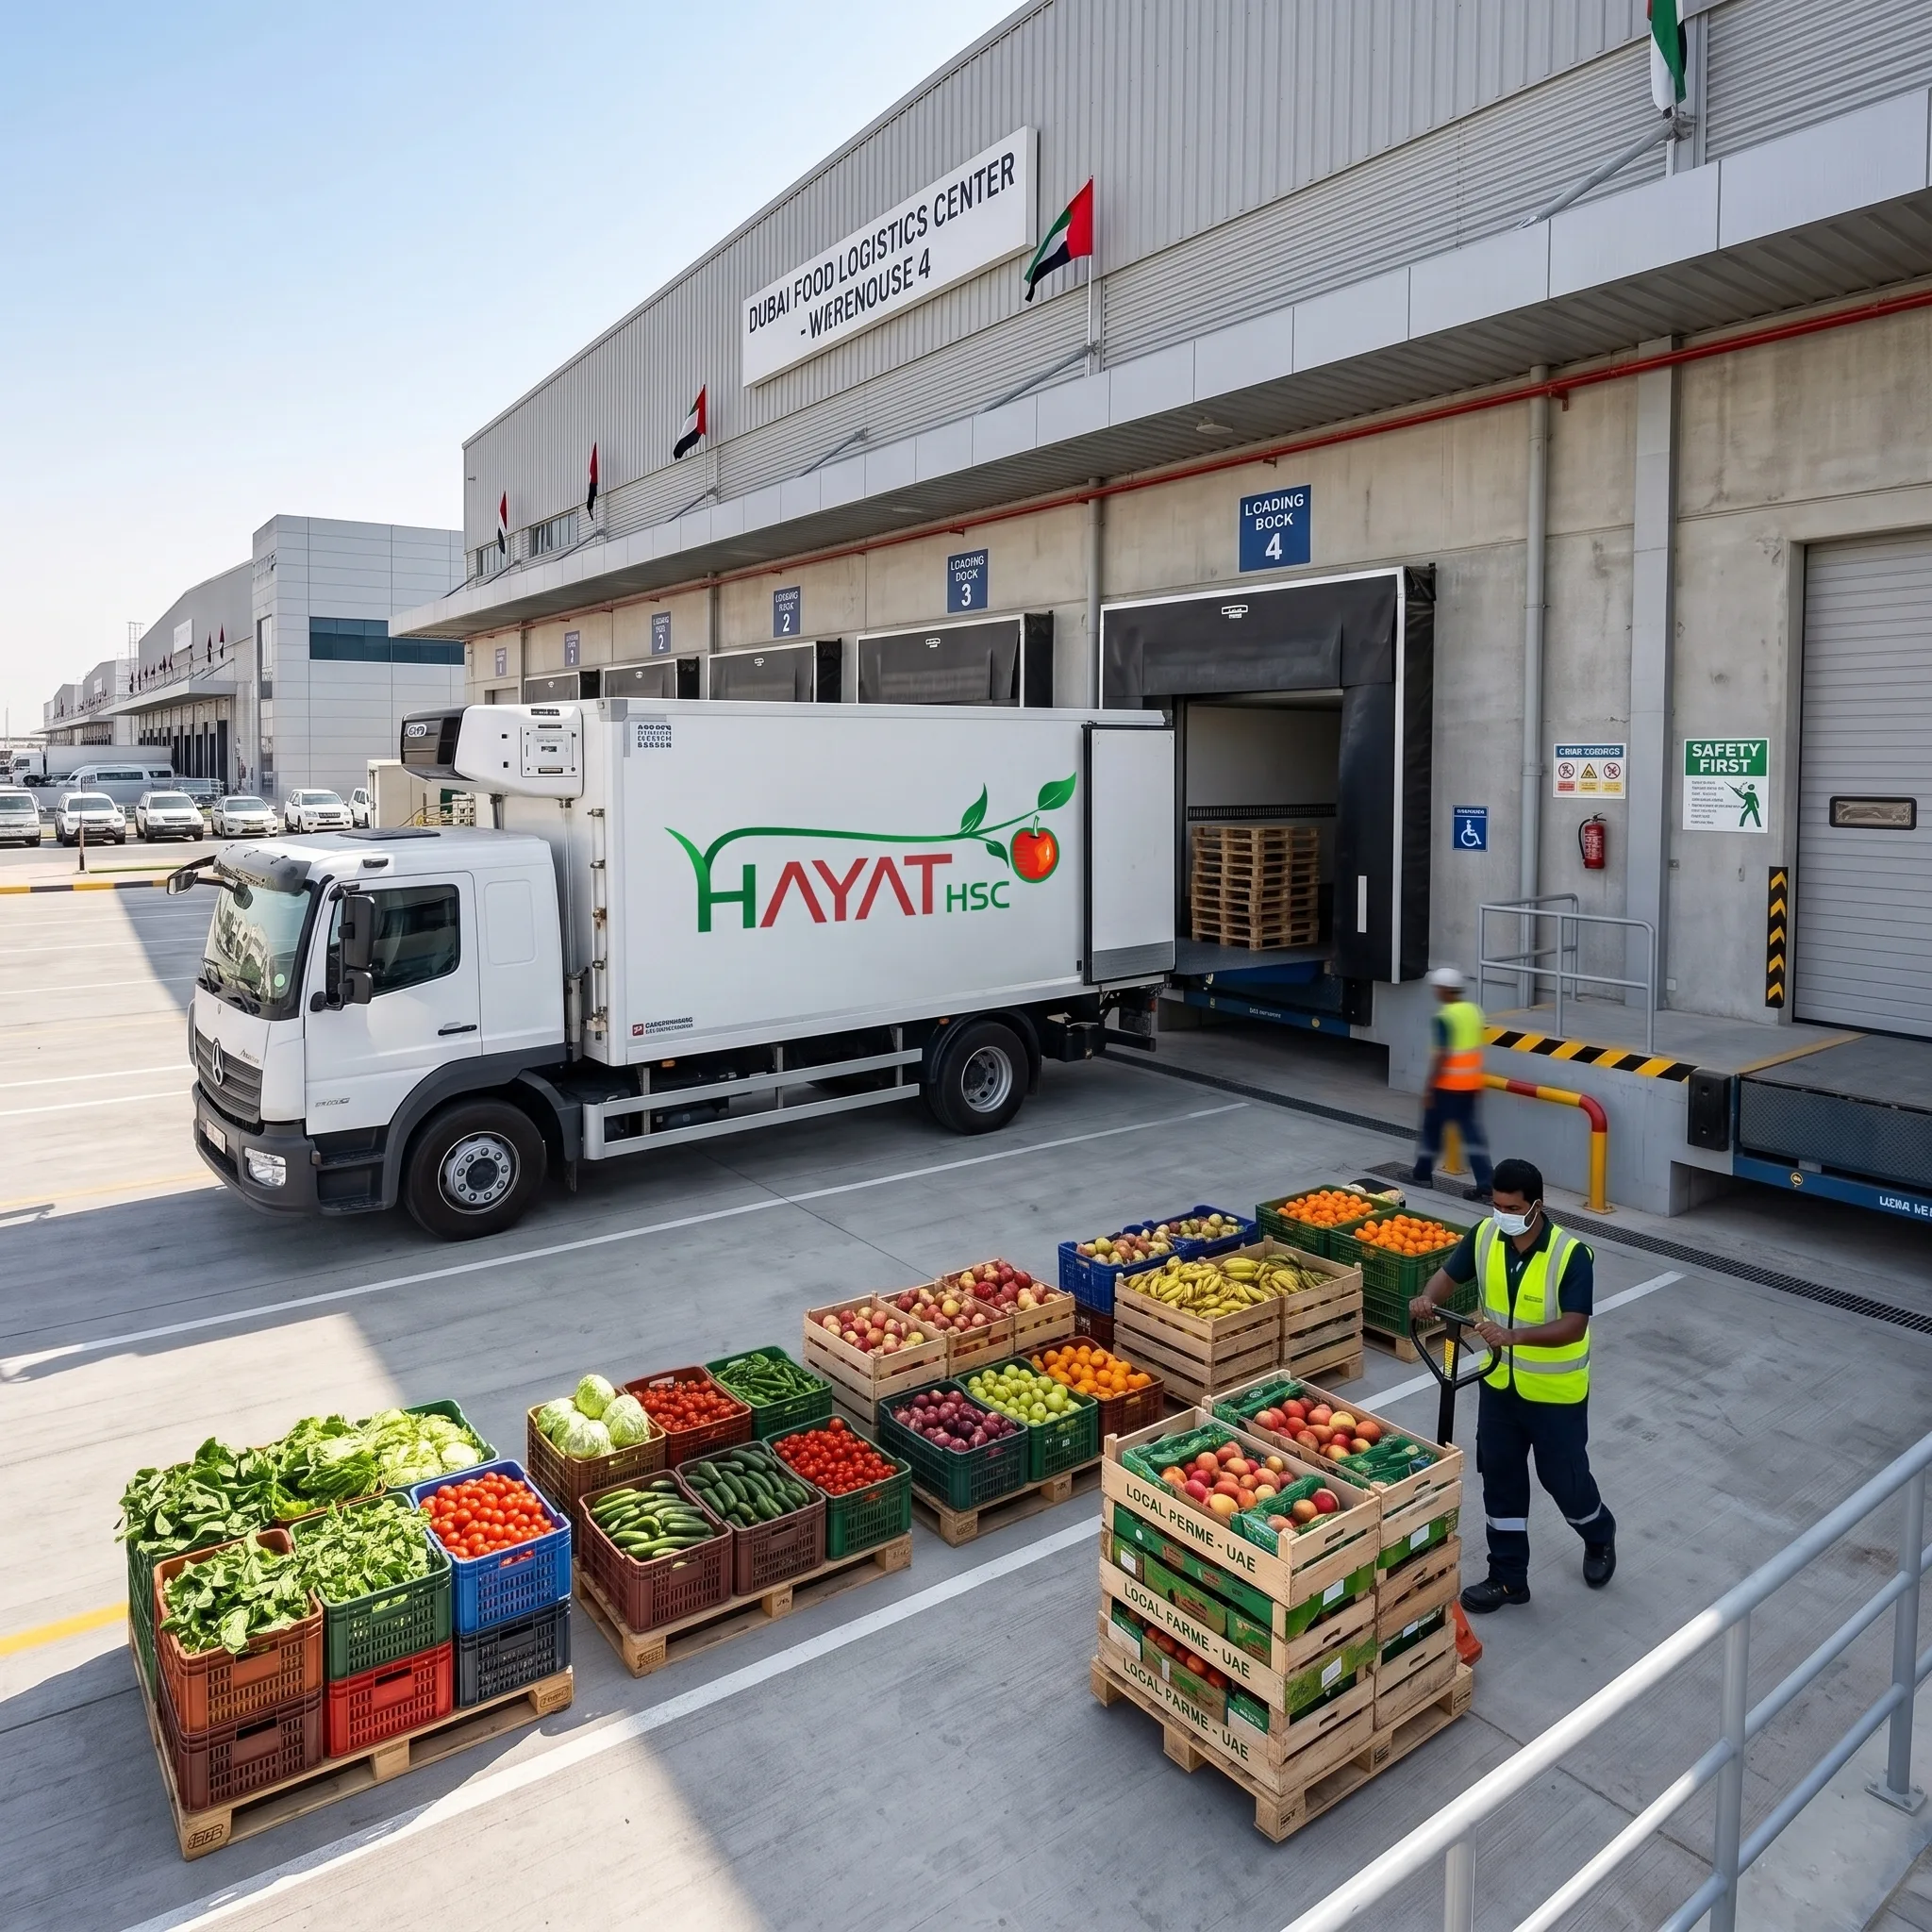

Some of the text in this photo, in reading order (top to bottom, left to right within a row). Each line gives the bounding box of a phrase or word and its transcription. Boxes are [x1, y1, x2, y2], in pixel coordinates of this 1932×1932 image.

[749, 152, 1015, 334] DUBAI FOOD LOGISTICS CENTER
[918, 247, 931, 279] 4
[1245, 493, 1305, 517] LOADING
[1256, 512, 1293, 531] BOCK
[1265, 532, 1283, 560] 4
[956, 568, 978, 582] DOCK
[960, 583, 972, 607] 3
[782, 613, 791, 633] 2
[658, 634, 664, 650] 2
[1691, 742, 1761, 757] SAFETY
[1699, 758, 1752, 773] FIRST
[697, 852, 1010, 933] HAYAT HSC
[1126, 1483, 1166, 1519] LOCAL
[1169, 1508, 1214, 1548] PERME
[1226, 1543, 1256, 1574] UAE
[1124, 1582, 1163, 1621] LOCAL
[1166, 1610, 1209, 1652] FARME
[1222, 1648, 1250, 1679] UAE
[1165, 1687, 1208, 1732] PARME
[1222, 1729, 1249, 1762] UAE
